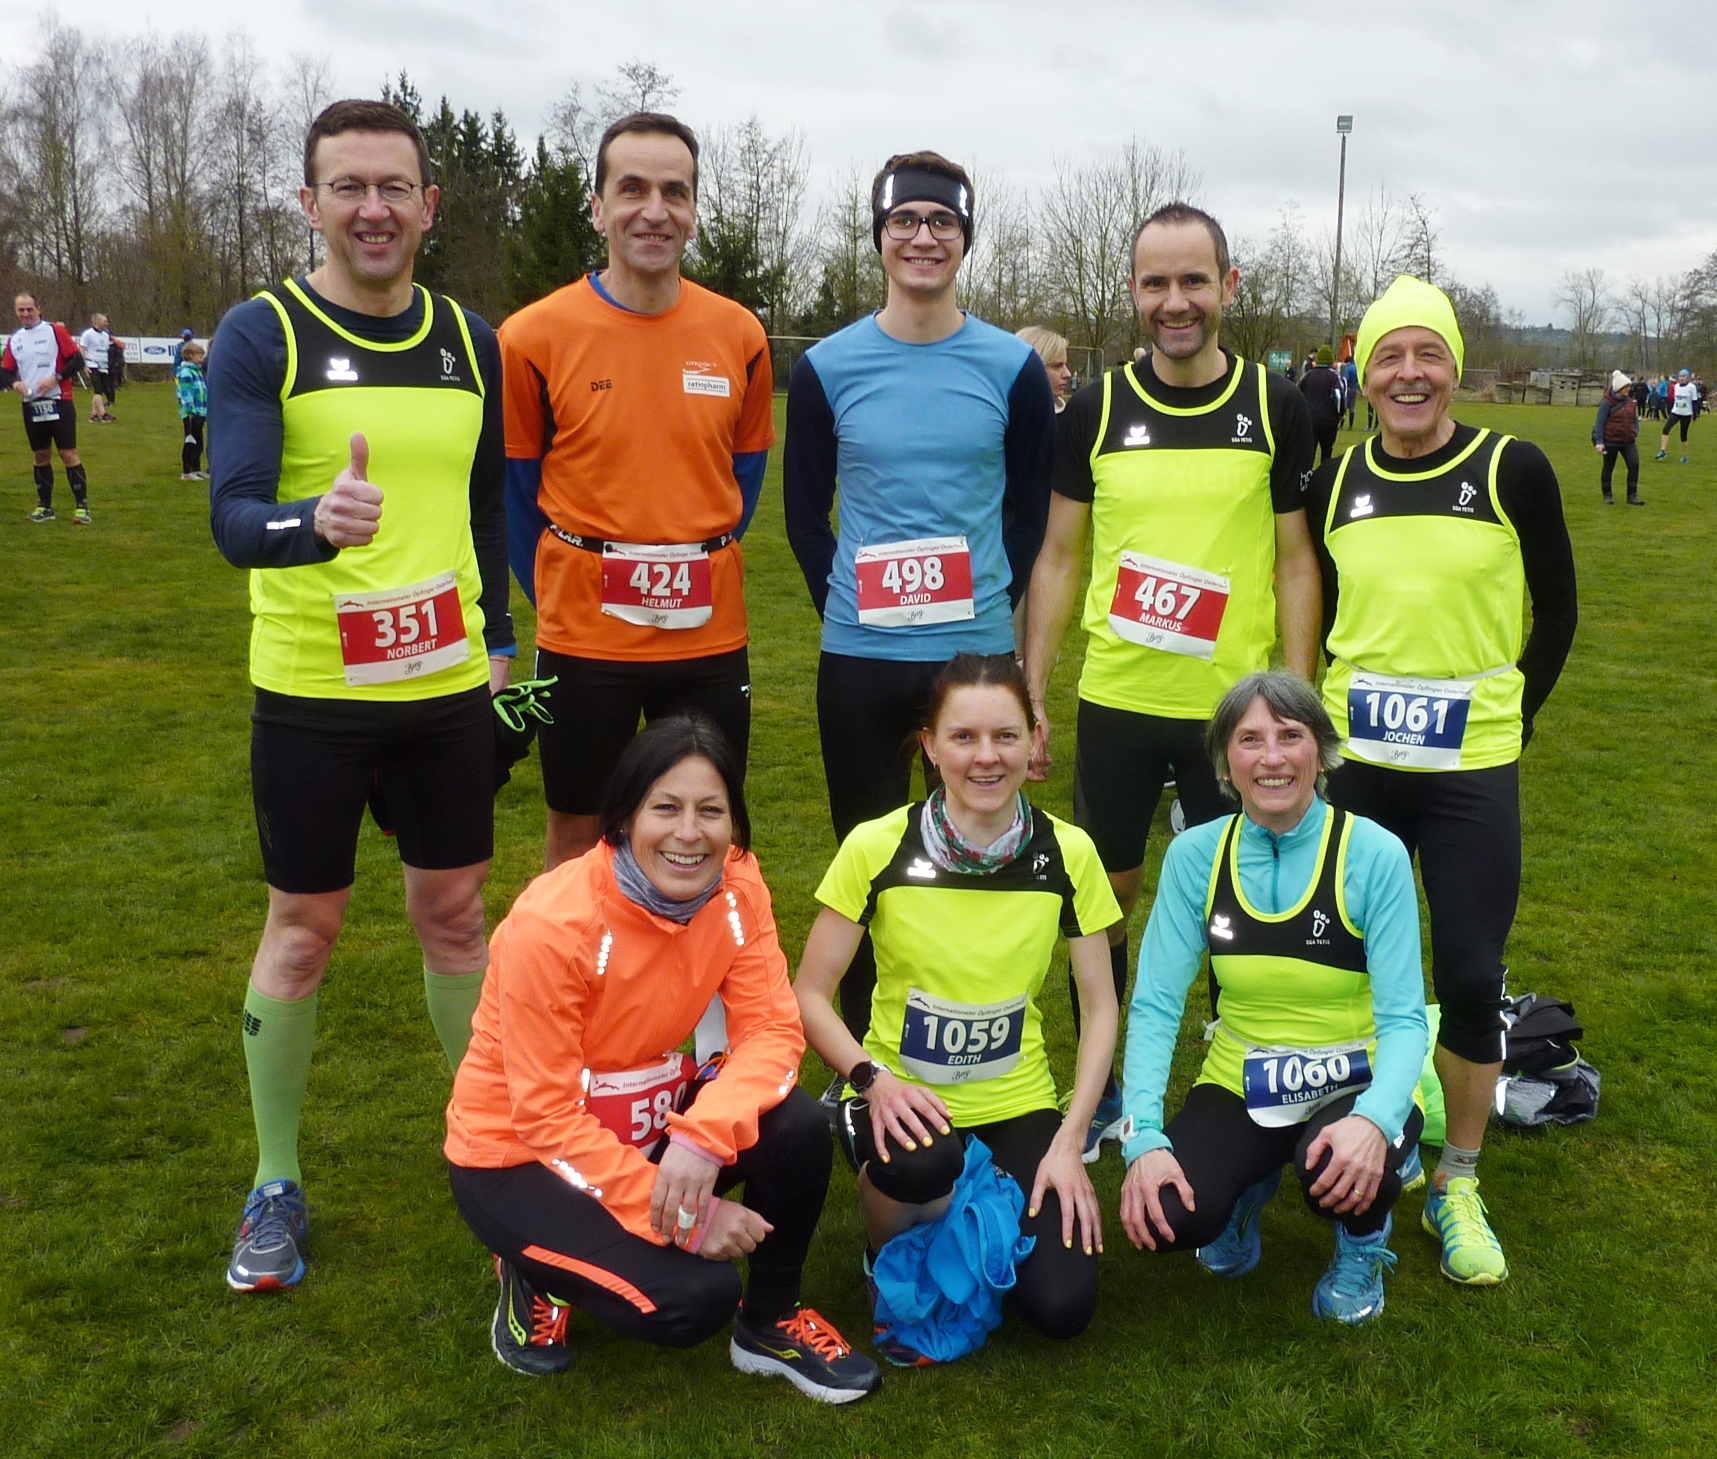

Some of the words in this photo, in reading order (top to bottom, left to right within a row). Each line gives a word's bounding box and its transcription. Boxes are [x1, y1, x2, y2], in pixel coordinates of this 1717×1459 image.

[590, 379, 612, 392] DEE
[688, 381, 726, 391] ratiopharm
[916, 545, 940, 553] Öpfinger
[630, 562, 692, 597] 424
[882, 556, 945, 594] 498
[1140, 563, 1179, 577] Internationaler
[1179, 572, 1204, 584] Öpfinger
[367, 593, 412, 606] Internationaler
[412, 587, 435, 598] Öpfinger
[641, 597, 683, 609] HELMUT
[900, 593, 932, 605] DAVID
[1134, 576, 1201, 620] 467
[372, 599, 438, 648] 351
[1139, 612, 1183, 632] MARKUS
[387, 638, 437, 660] NORBERT
[1417, 684, 1442, 693] Öpfinger
[1366, 692, 1449, 734] 1061
[1383, 731, 1425, 745] JOCHEN
[932, 1004, 976, 1016] Internationaler
[978, 1006, 1002, 1017] Öpfinger
[923, 1015, 1010, 1054] 1059
[947, 1054, 981, 1065] EDITH
[623, 1072, 669, 1088] Internationaler
[1263, 1055, 1350, 1093] 1060
[1282, 1083, 1339, 1104] ELISABETH
